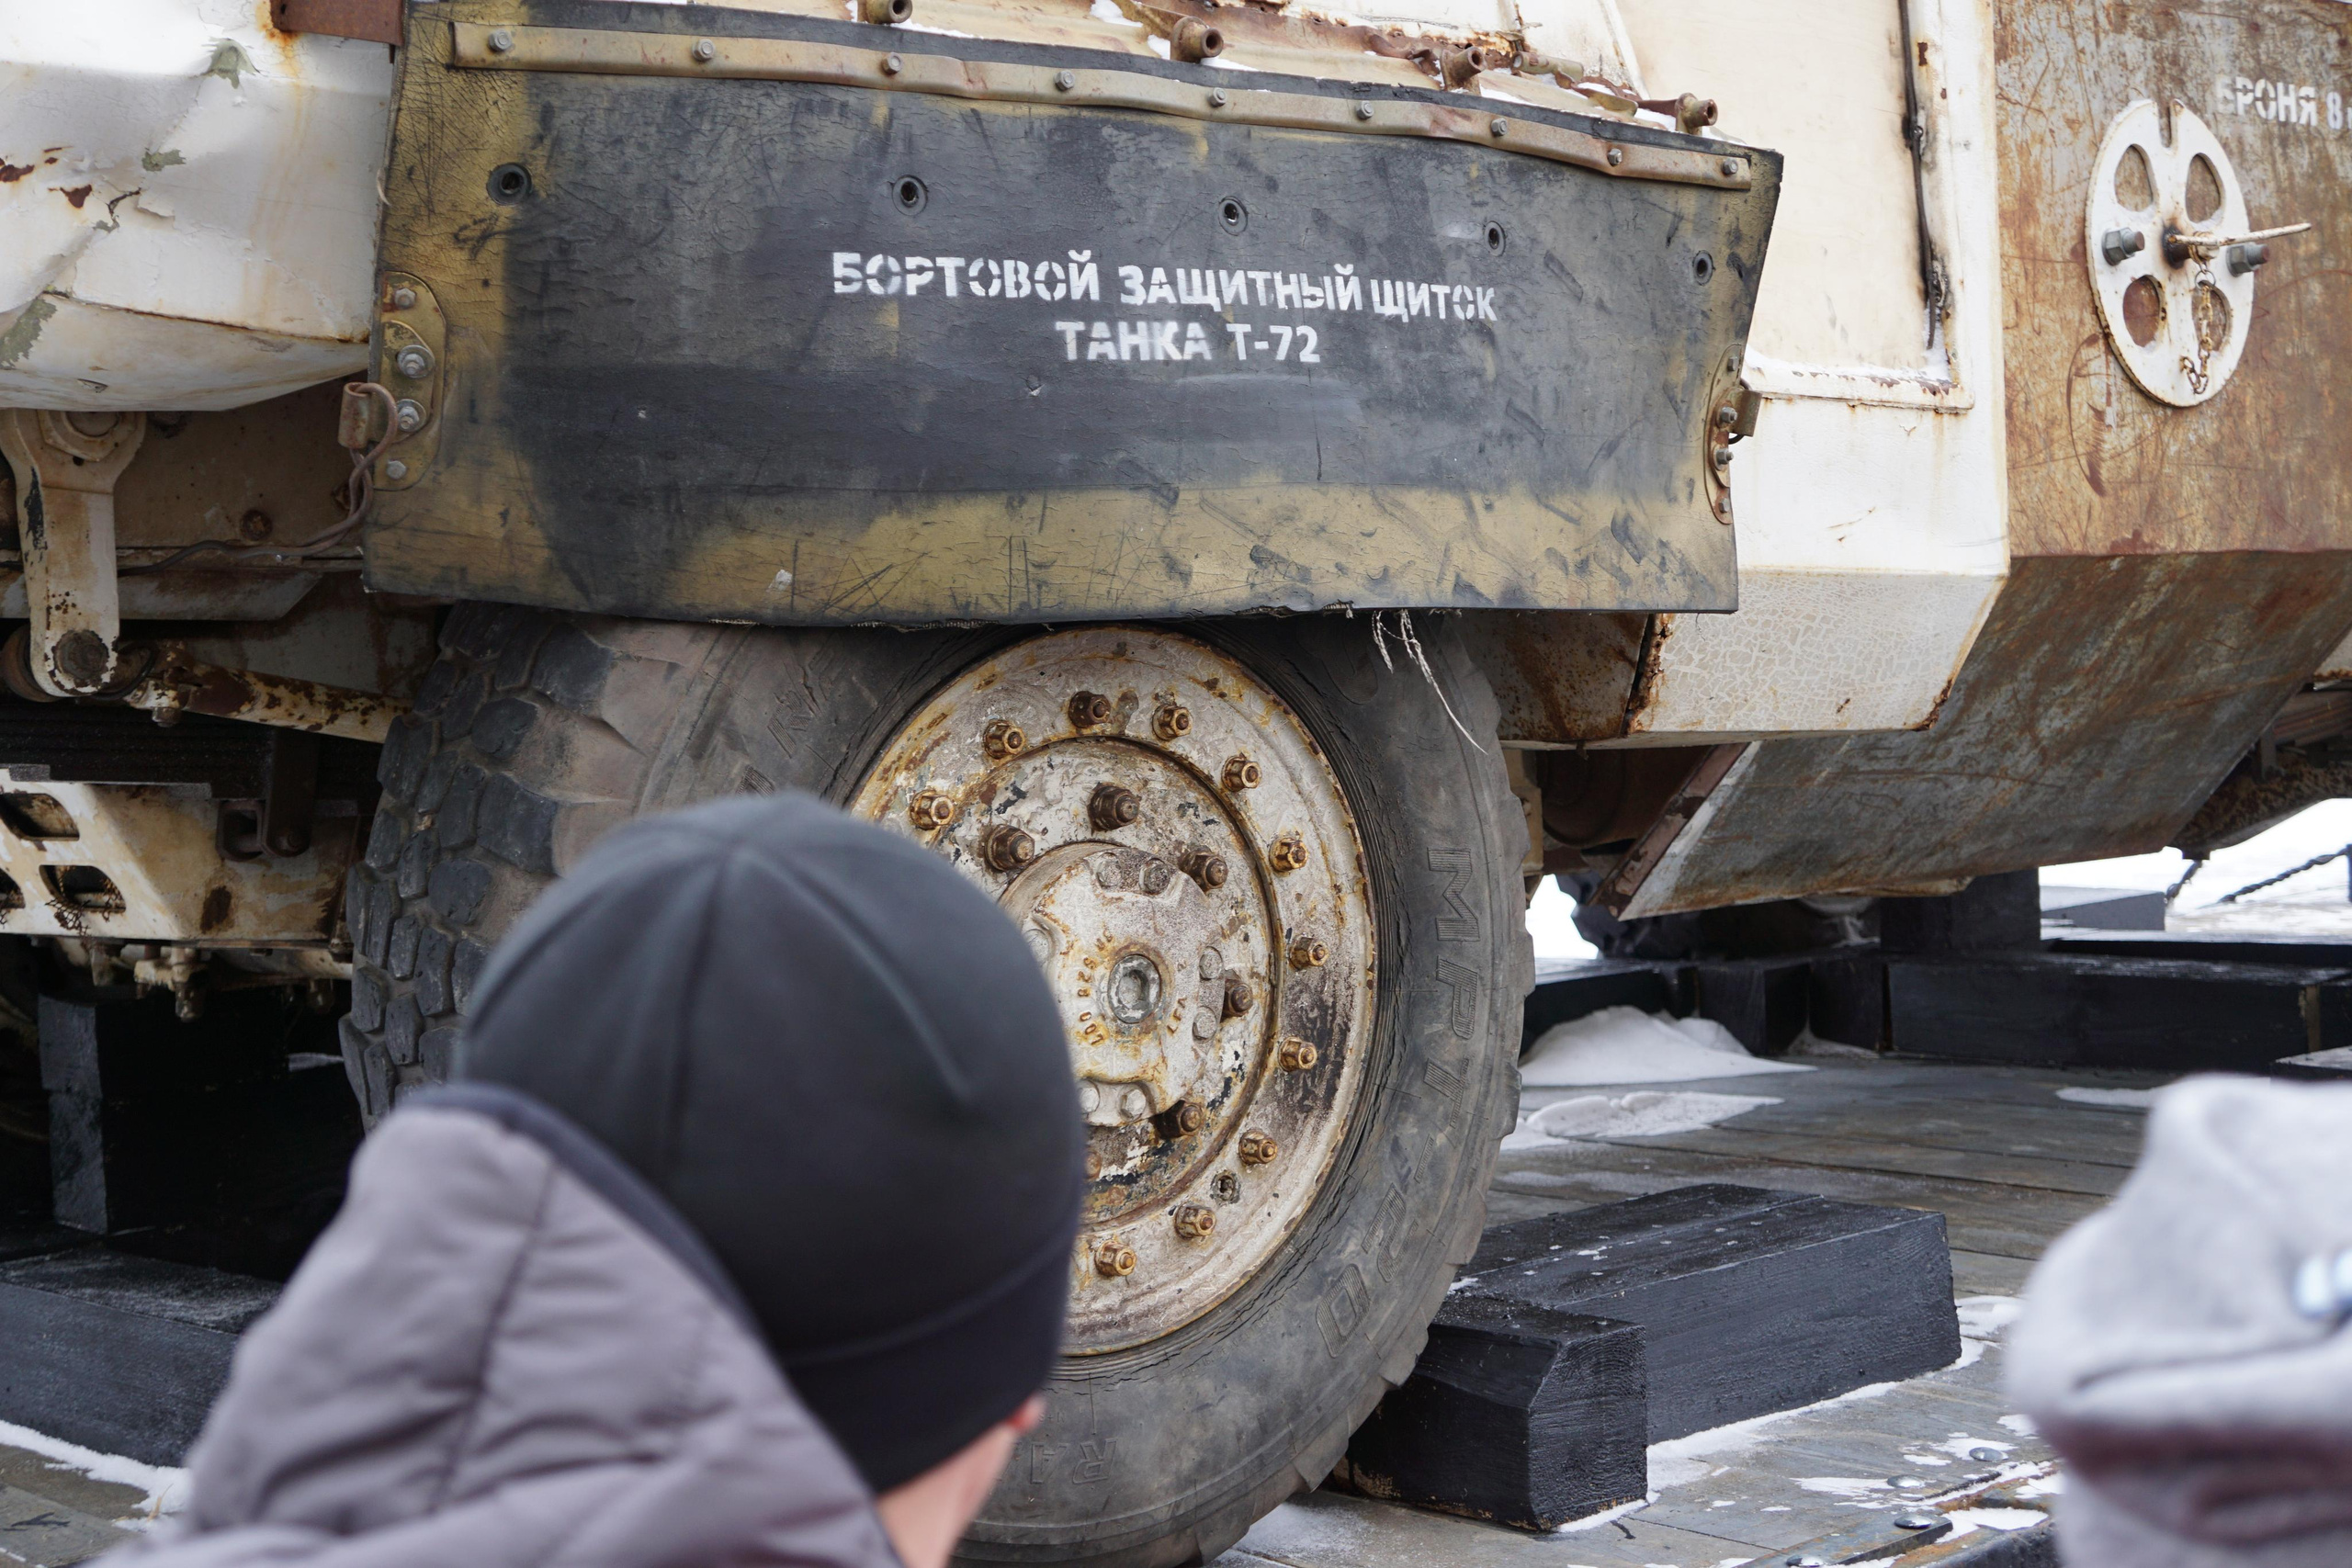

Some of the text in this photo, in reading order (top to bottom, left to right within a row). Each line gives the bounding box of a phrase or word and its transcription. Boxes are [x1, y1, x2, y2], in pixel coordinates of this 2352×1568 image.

[2215, 73, 2318, 127] БРОНЯ
[832, 249, 1498, 323] БОРТОВОЙ ЗАЩИТНЫЙ ЩИТОК
[1055, 320, 1322, 364] ТАНКА Т-72
